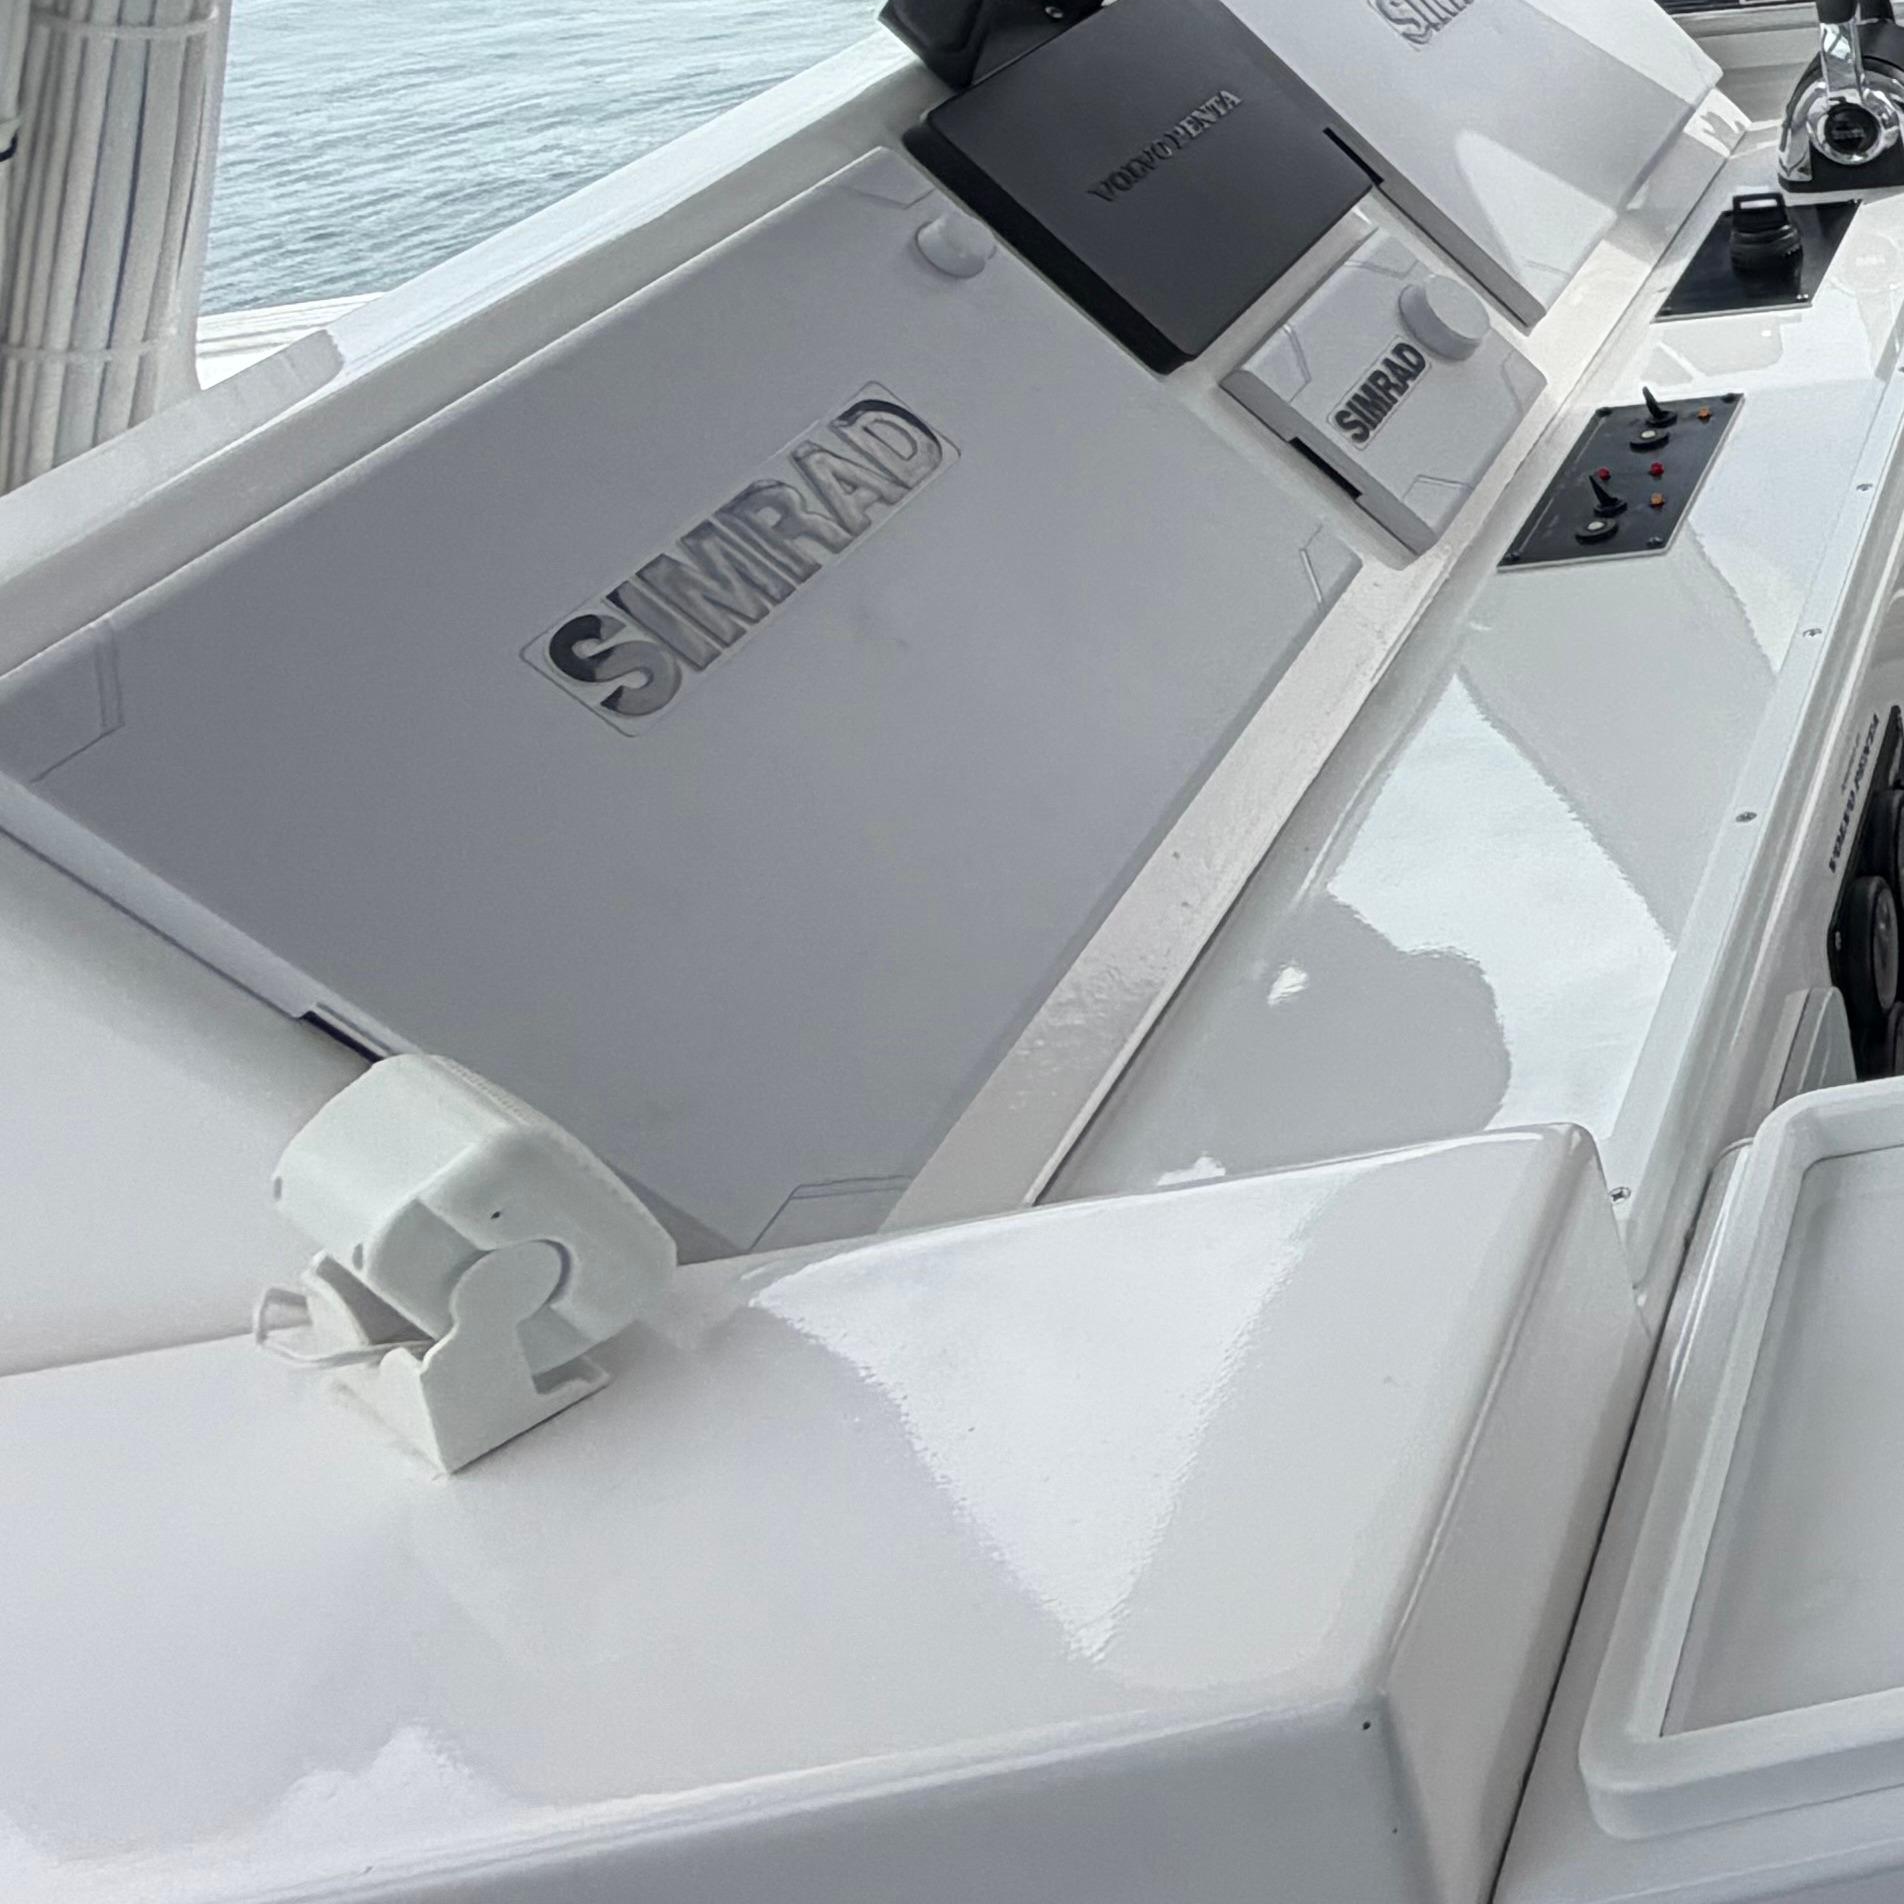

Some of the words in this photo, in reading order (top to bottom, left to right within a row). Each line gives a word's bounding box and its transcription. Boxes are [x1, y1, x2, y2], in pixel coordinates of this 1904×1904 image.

[1086, 138, 1173, 202] VOLVO
[1335, 342, 1426, 443] SIMRAD
[548, 399, 943, 716] SIMRAD
